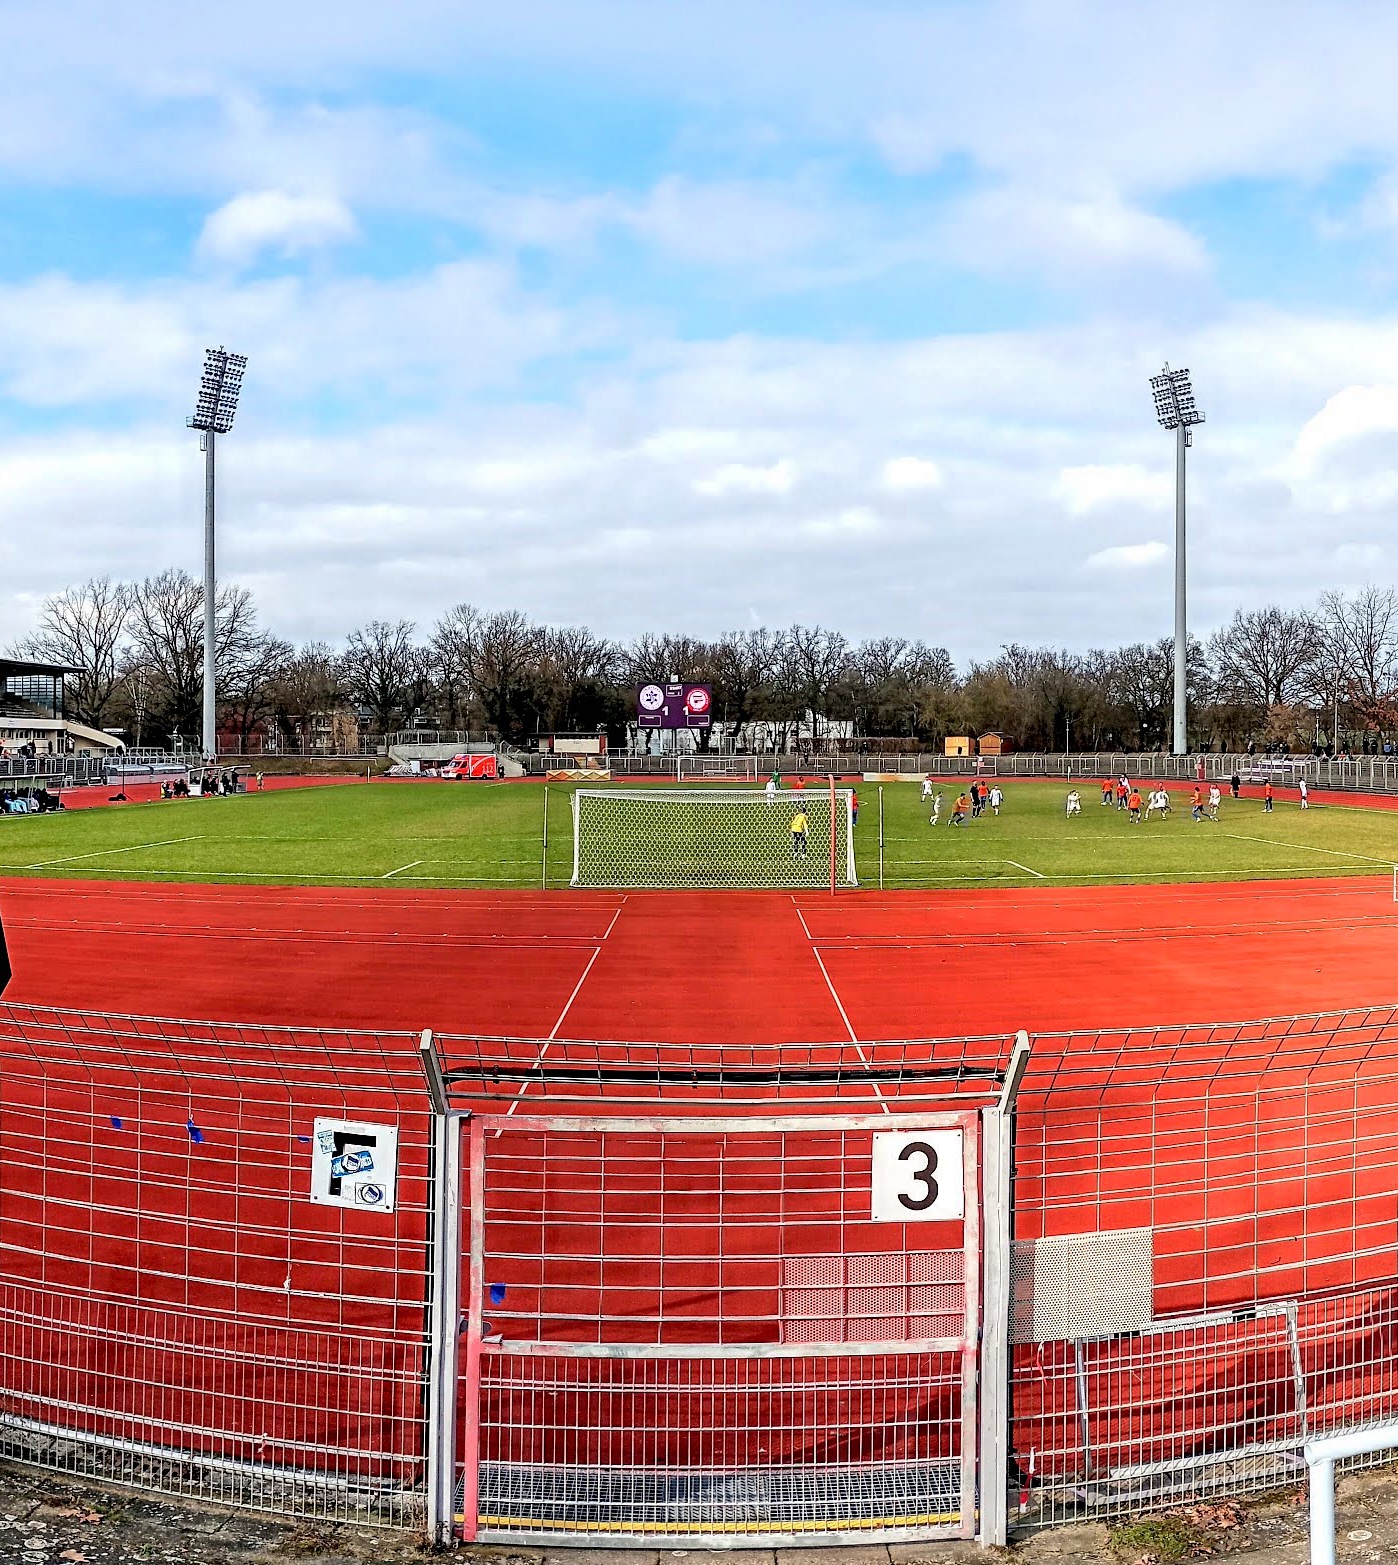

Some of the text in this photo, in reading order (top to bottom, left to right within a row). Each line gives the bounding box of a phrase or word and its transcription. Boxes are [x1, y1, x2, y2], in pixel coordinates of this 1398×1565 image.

[662, 706, 669, 716] 1
[683, 706, 689, 716] 1
[328, 1131, 376, 1196] F
[897, 1141, 938, 1210] 3
